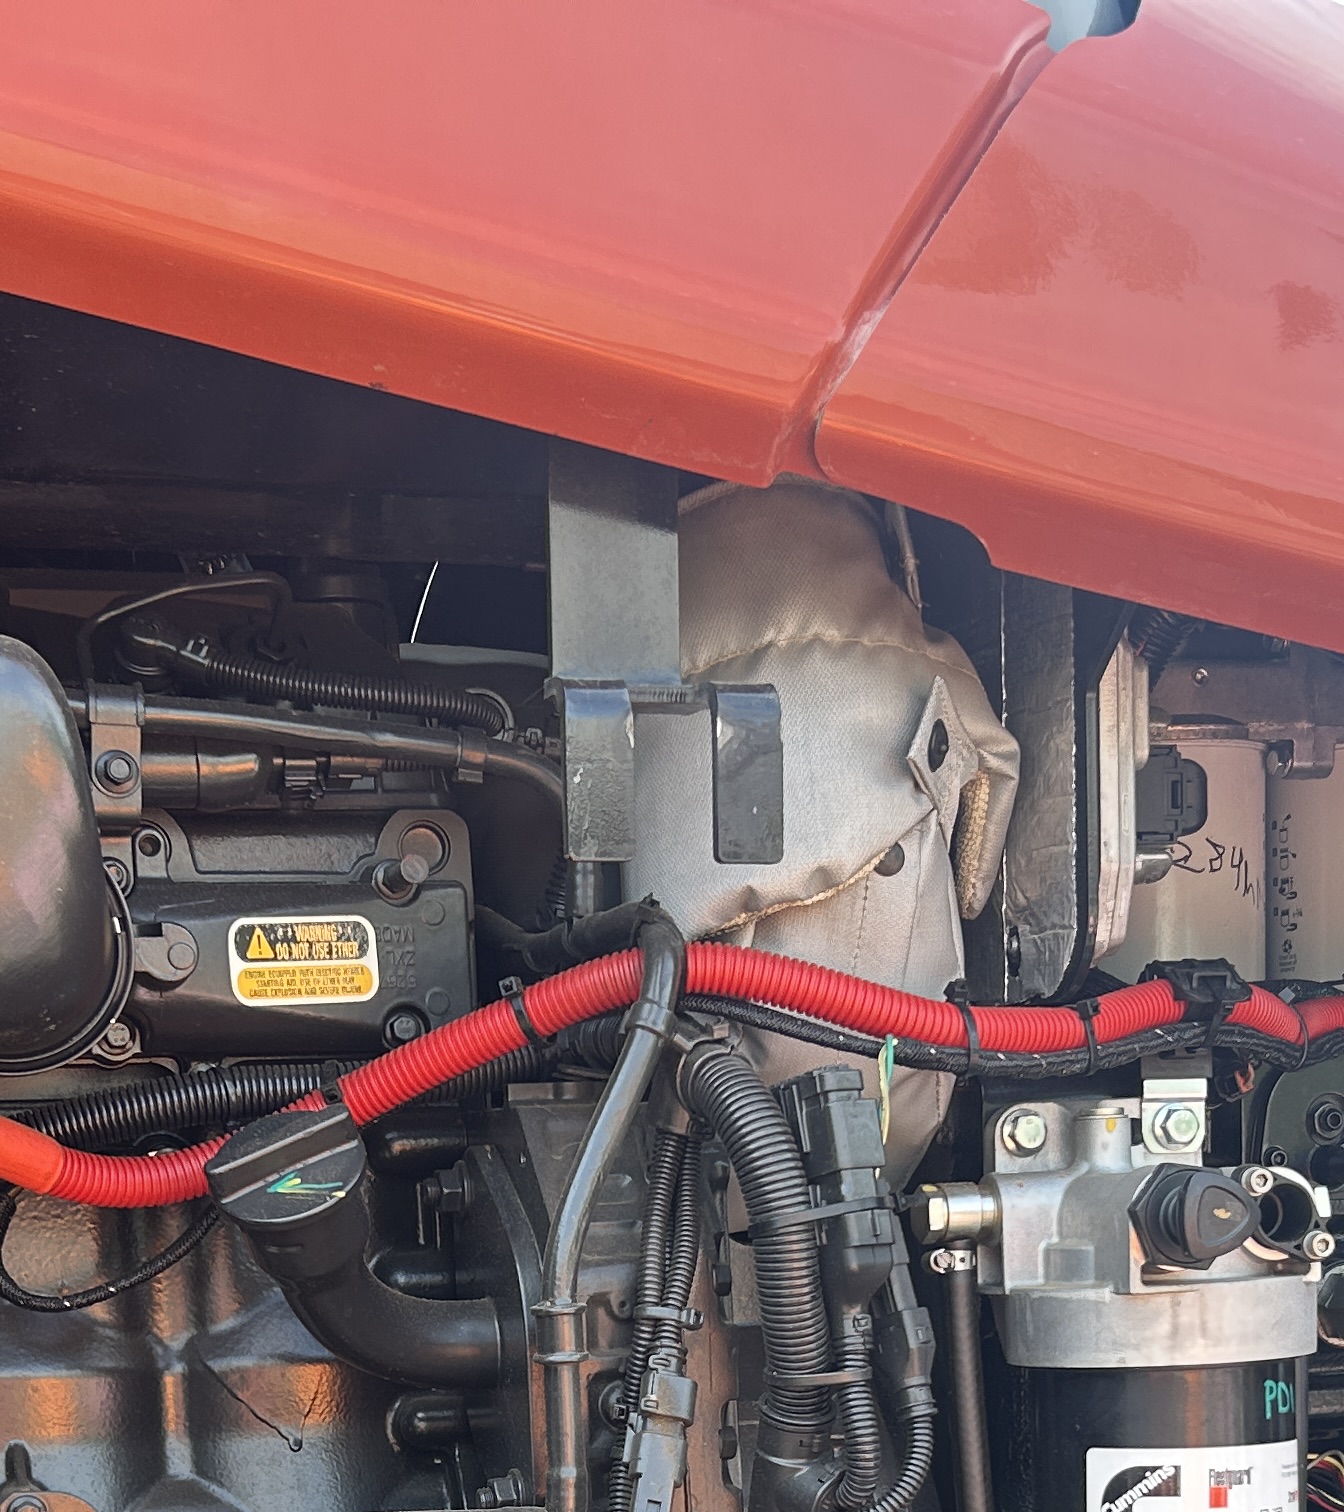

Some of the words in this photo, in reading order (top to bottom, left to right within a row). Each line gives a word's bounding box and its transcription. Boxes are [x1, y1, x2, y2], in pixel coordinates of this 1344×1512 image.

[294, 924, 338, 941] WARNING
[276, 943, 288, 960] DO
[291, 942, 309, 959] NOT
[313, 942, 330, 959] USE
[332, 941, 359, 958] ETHER
[1264, 1379, 1295, 1420] PDI
